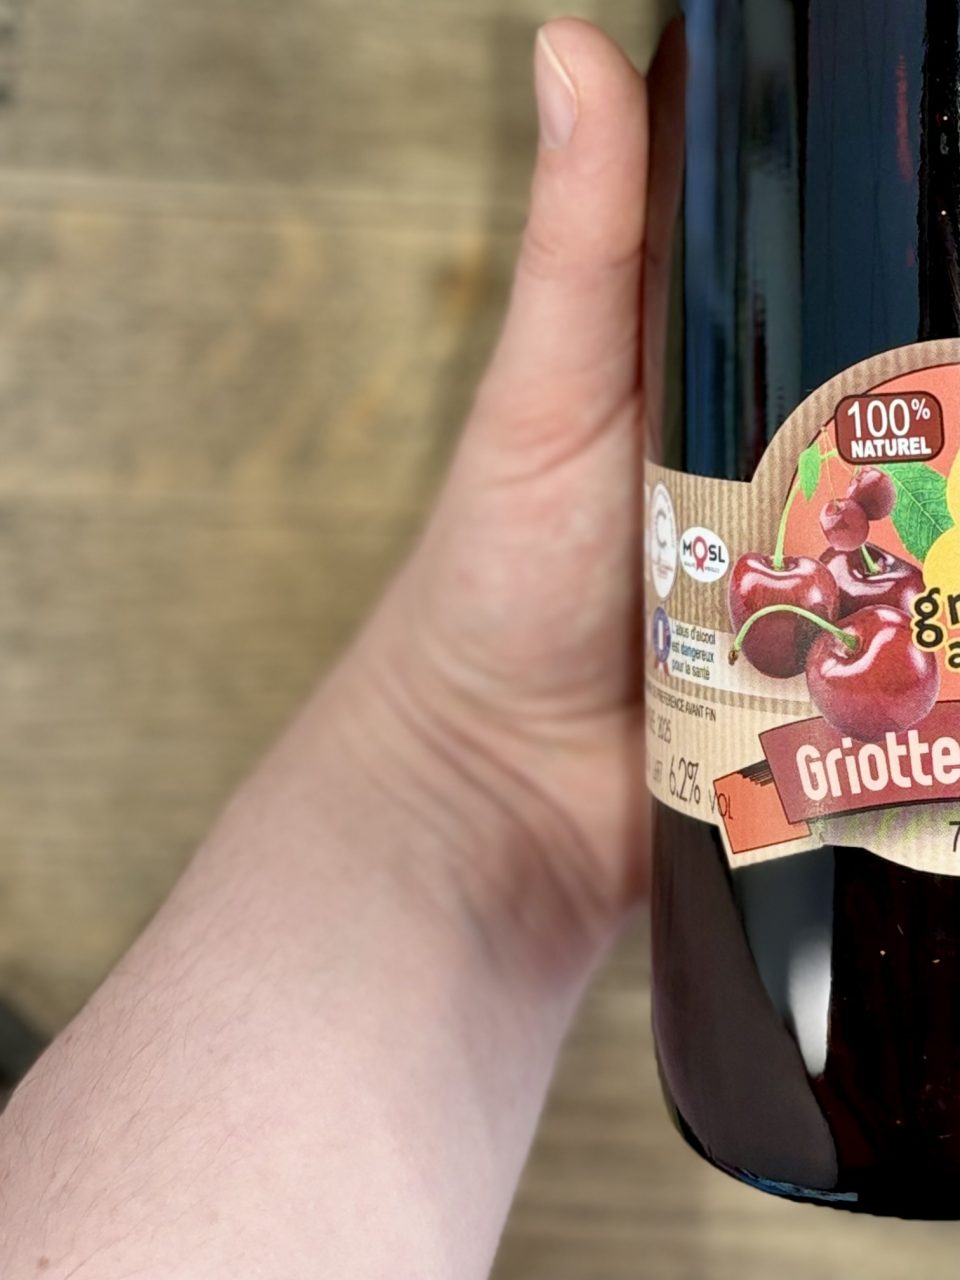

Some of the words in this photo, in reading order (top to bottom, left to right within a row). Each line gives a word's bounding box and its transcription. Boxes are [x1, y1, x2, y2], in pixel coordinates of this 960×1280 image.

[847, 398, 931, 438] 100%
[851, 436, 932, 458] NATUREL
[704, 706, 717, 723] FIN
[708, 788, 734, 820] VOL
